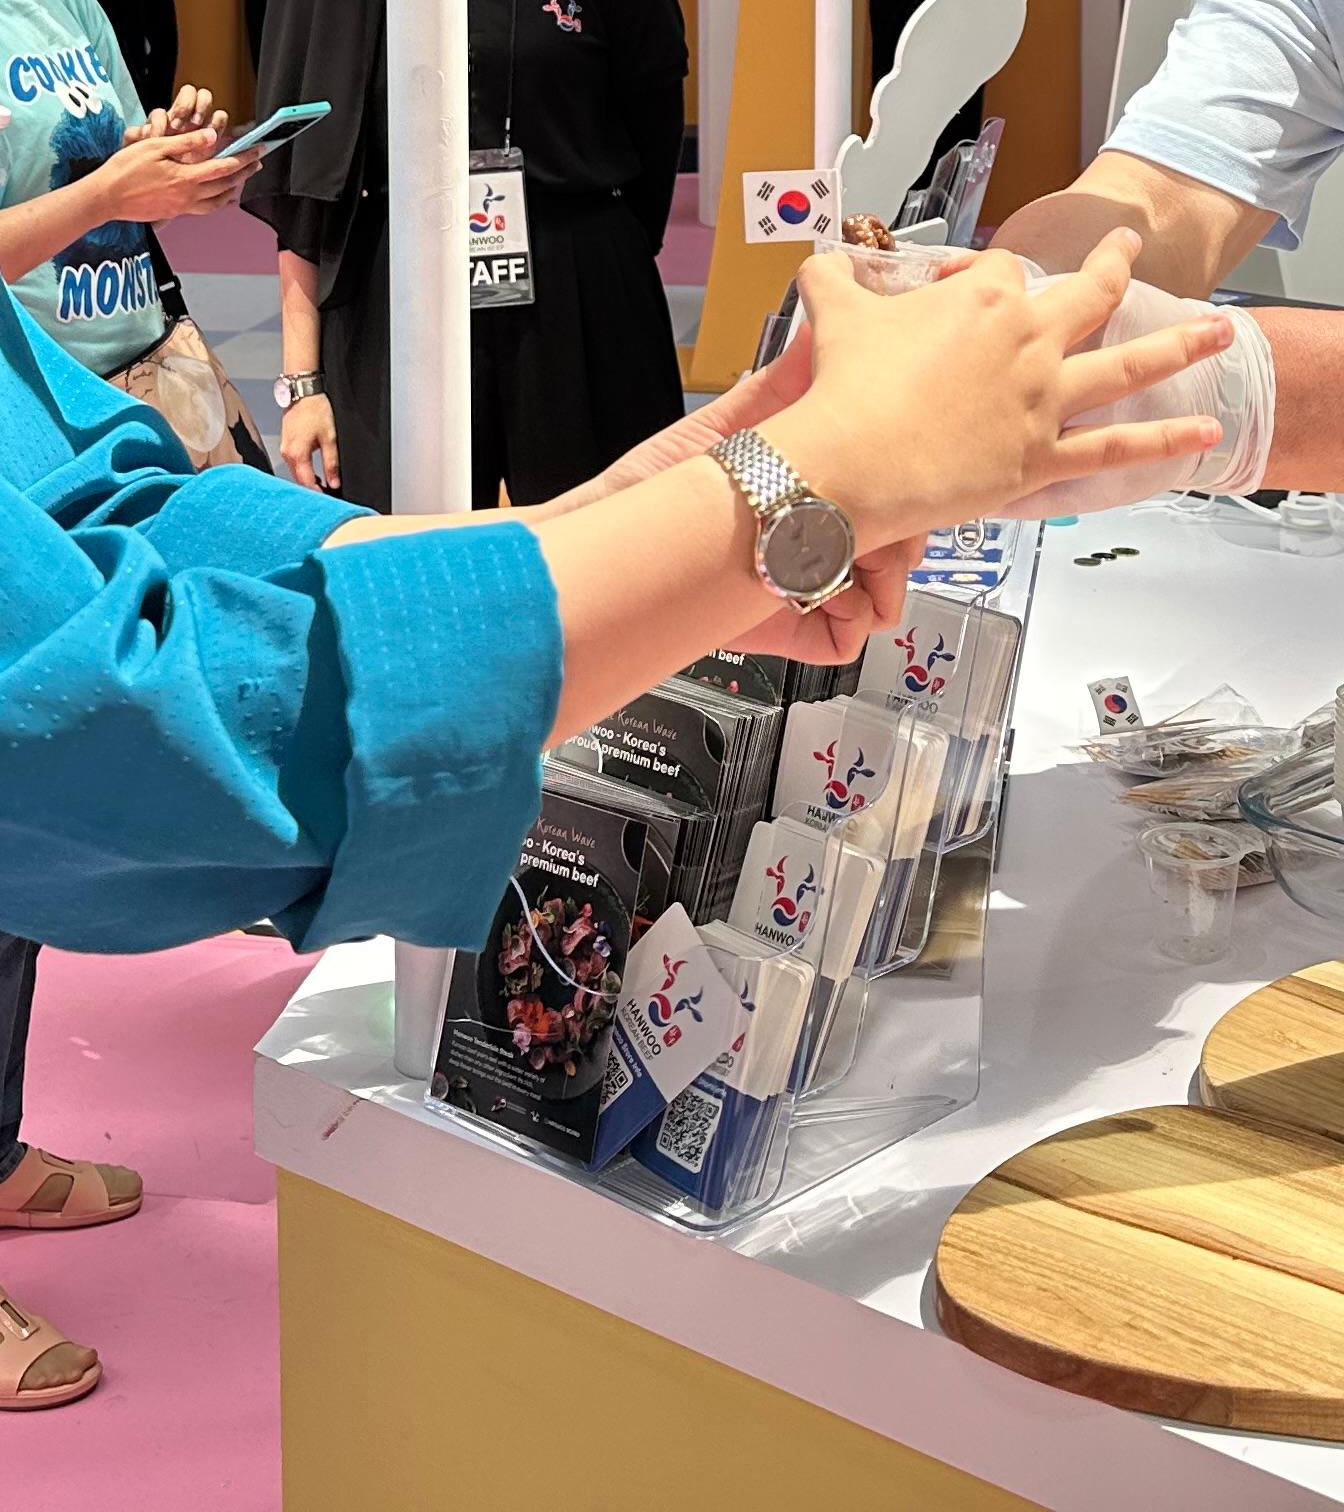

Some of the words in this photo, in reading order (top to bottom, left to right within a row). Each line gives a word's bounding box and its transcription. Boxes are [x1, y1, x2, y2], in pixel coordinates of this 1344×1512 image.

[617, 709, 649, 733] Korean
[653, 719, 678, 741] Wave
[601, 743, 651, 769] premium
[652, 757, 682, 778] beef
[622, 731, 667, 757] Korea's
[536, 815, 568, 841] Korean
[571, 826, 597, 849] Wave
[519, 851, 570, 879] premium
[571, 865, 601, 888] beef
[541, 839, 586, 866] Korea's
[626, 998, 662, 1056] HANWOO
